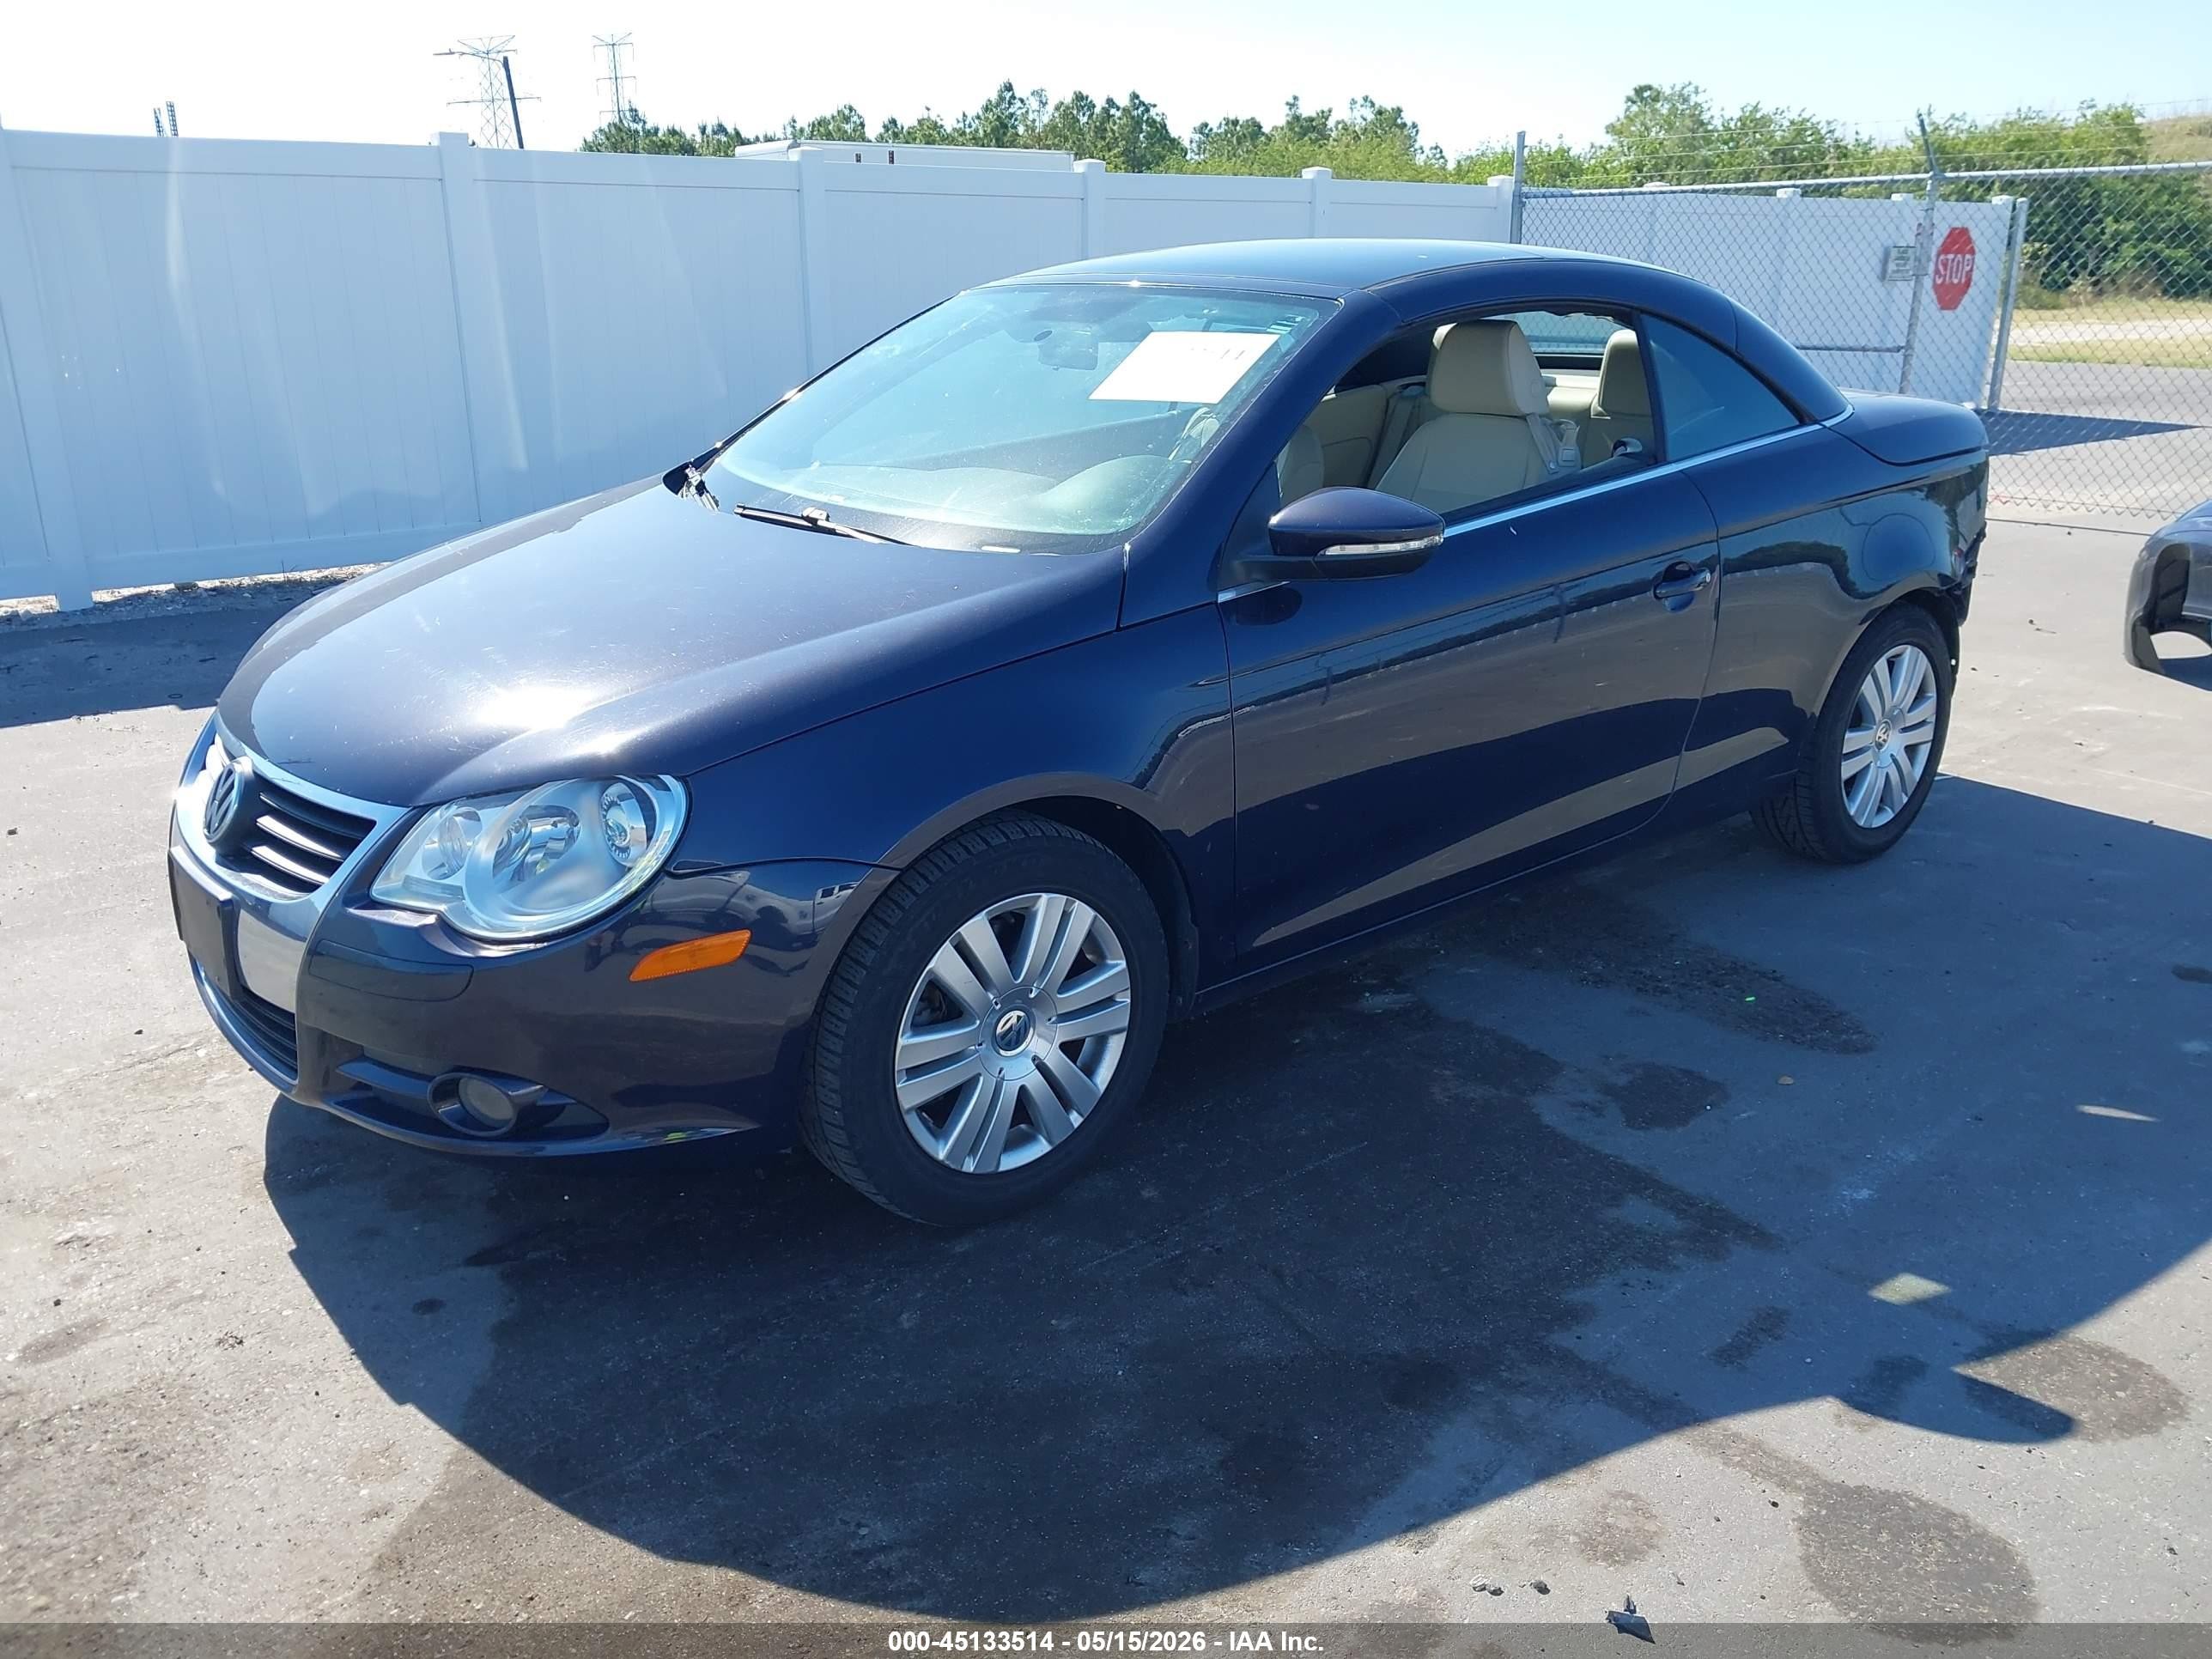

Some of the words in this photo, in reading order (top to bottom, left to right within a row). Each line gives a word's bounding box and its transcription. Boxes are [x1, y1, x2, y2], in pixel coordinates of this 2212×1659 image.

[1935, 253, 1973, 285] STOP
[204, 763, 236, 837] VW
[996, 1010, 1033, 1055] VW
